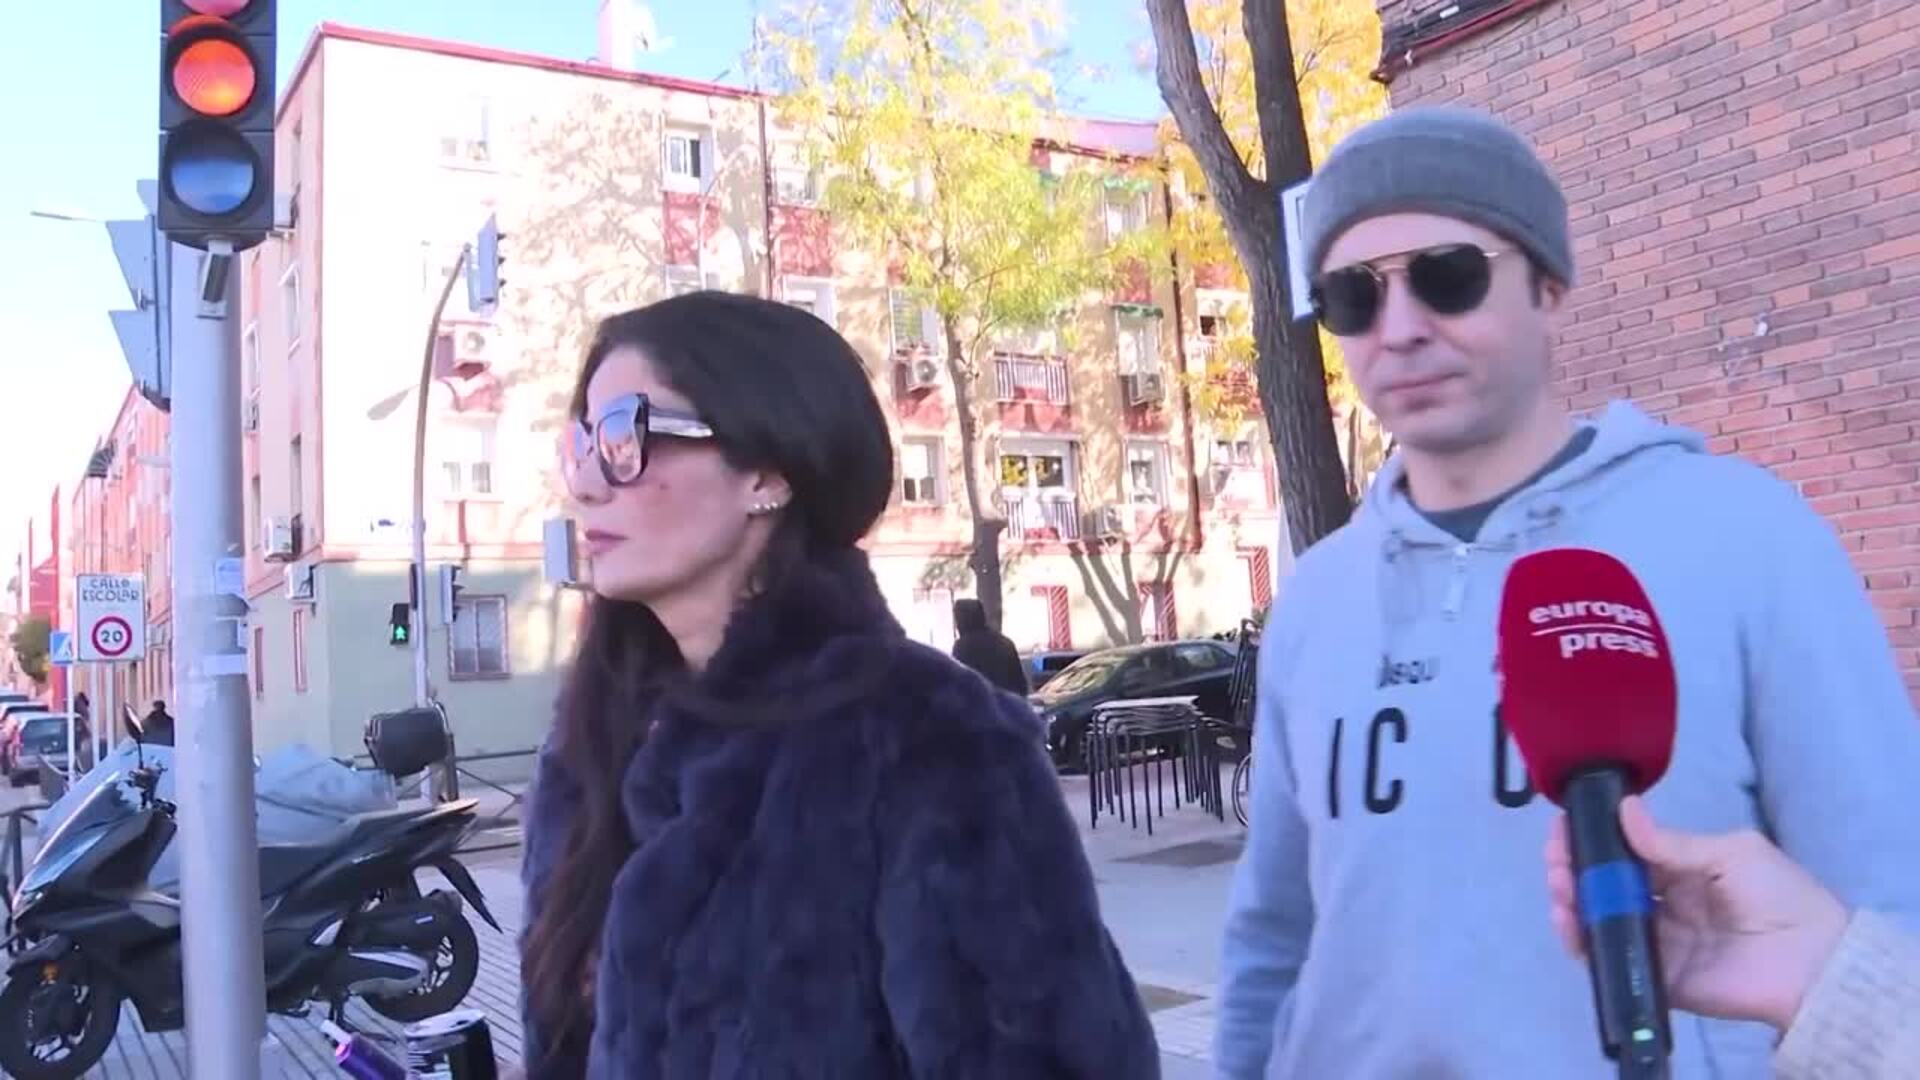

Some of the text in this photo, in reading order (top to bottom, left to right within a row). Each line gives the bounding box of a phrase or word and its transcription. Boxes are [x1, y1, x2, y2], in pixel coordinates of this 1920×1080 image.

[82, 589, 140, 602] ESCOLAR
[1528, 600, 1652, 627] europa
[101, 629, 123, 643] 20
[1560, 633, 1659, 658] press
